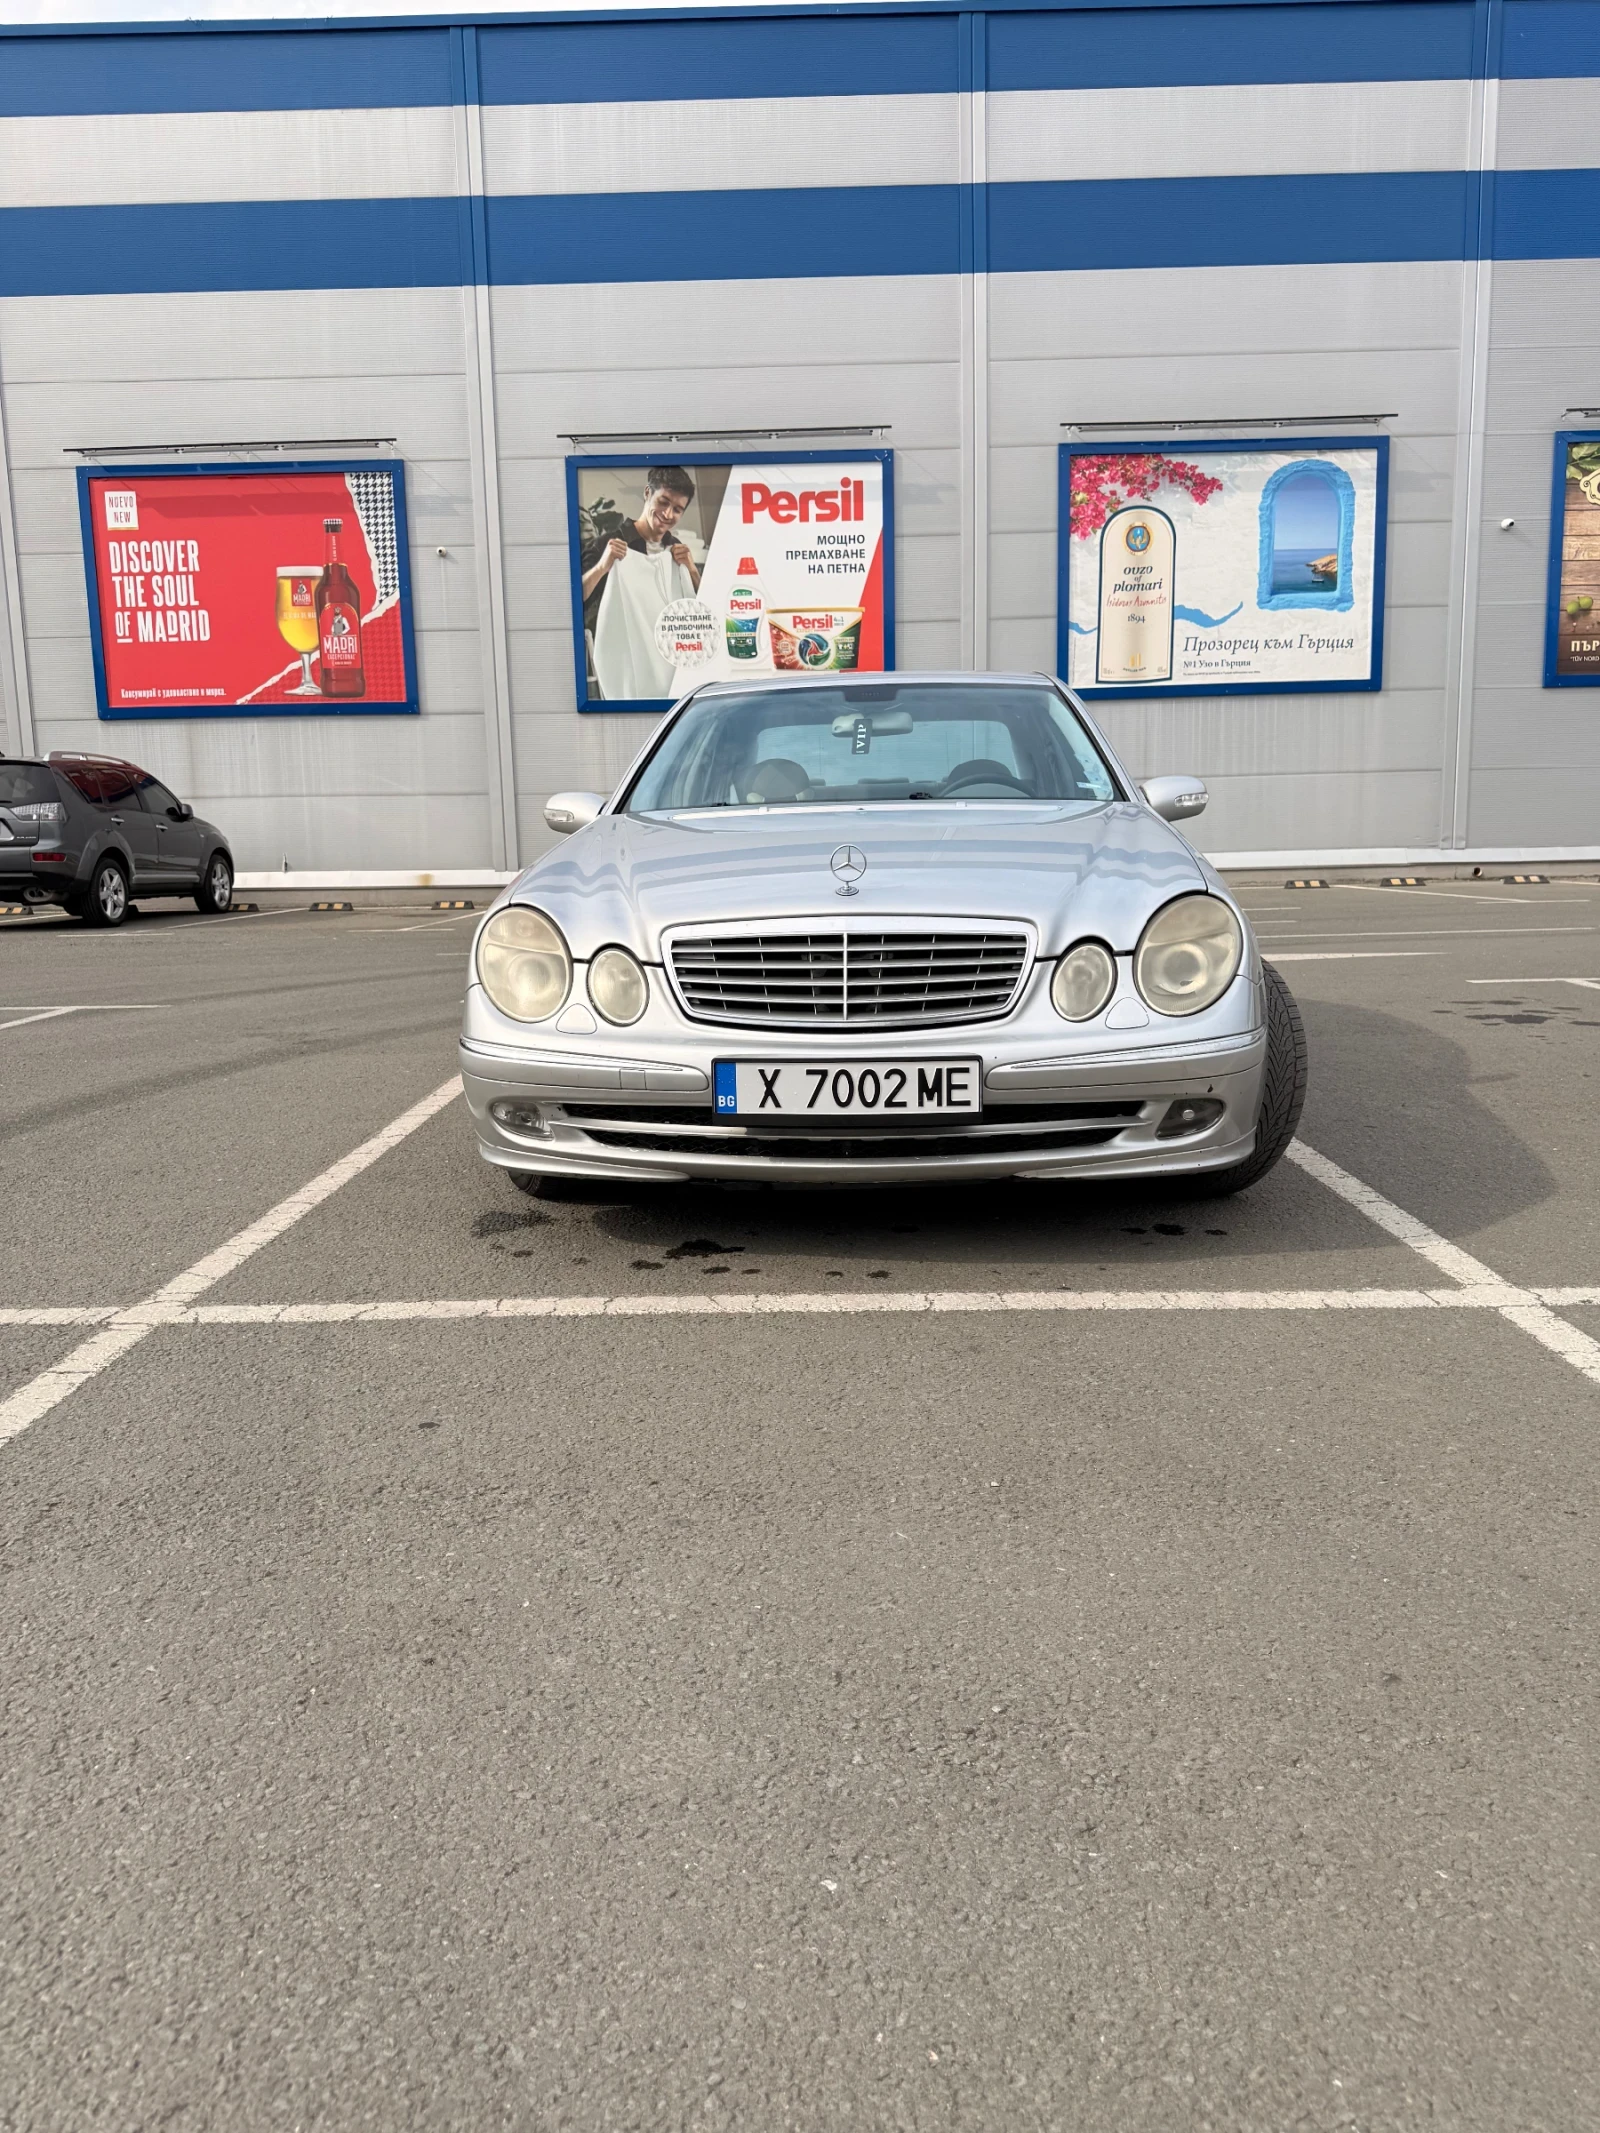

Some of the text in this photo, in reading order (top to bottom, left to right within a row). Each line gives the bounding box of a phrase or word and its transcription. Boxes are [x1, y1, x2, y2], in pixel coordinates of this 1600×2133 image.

[108, 495, 134, 508] NUEVO
[741, 476, 864, 524] Persil
[113, 511, 131, 523] NEW
[816, 534, 866, 547] МОЩНО
[108, 540, 200, 574] DISCOVER
[785, 548, 866, 561] ПРЕМАХВАНЕ
[807, 563, 866, 574] НА ПЕТНА
[1123, 565, 1153, 576] ouzo
[1134, 575, 1142, 583] of
[111, 574, 199, 608] THE SOUL
[1113, 577, 1163, 595] plomari
[730, 598, 762, 611] Persil
[664, 614, 712, 622] ПОЧИСТВАНЕ
[792, 614, 833, 629] Persil
[1127, 613, 1146, 624] 1894
[115, 609, 211, 643] OF MADRID
[668, 623, 715, 632] ДЪЛБОЧИНА.
[675, 641, 703, 651] Persil
[1183, 634, 1354, 656] Прозорец към Гърция
[1199, 659, 1213, 668] Узо
[1221, 658, 1251, 669] Гърция
[856, 724, 866, 749] VIP
[758, 1067, 972, 1109] X 7002 ME
[717, 1095, 735, 1107] BG
